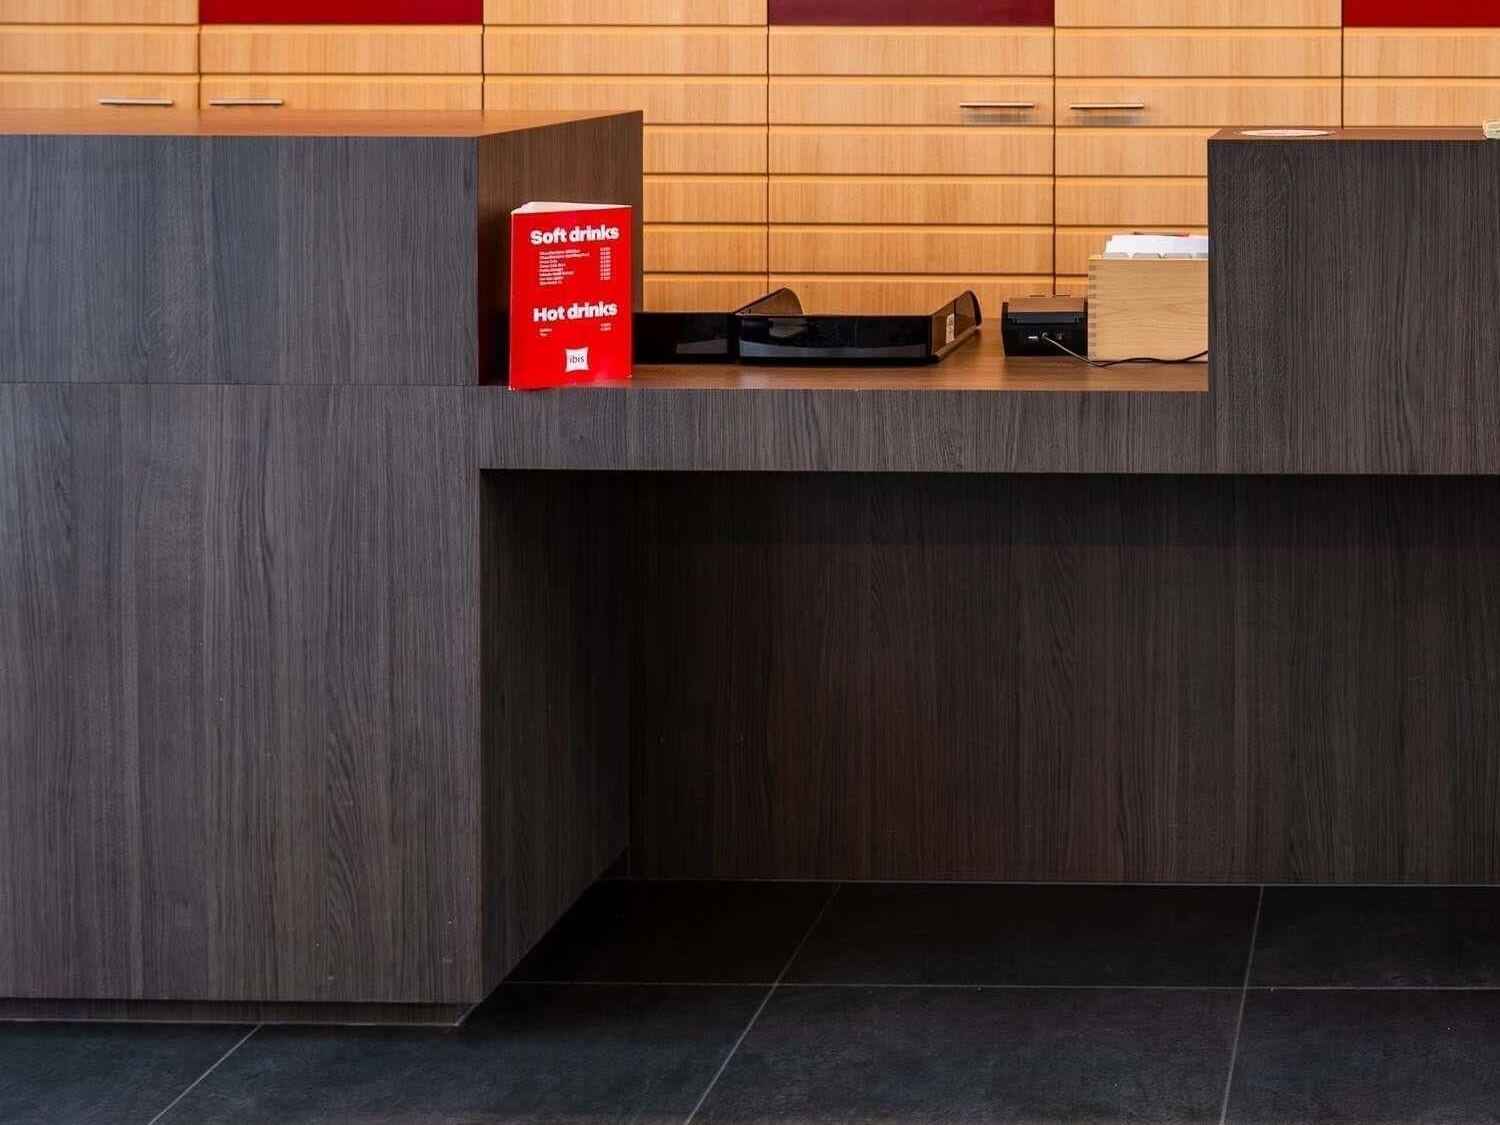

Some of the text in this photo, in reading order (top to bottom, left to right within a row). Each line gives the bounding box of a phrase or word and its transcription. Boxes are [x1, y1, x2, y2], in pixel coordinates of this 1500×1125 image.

[530, 225, 620, 245] Soft drinks
[533, 302, 618, 322] Hot drinks
[569, 355, 585, 364] ibis
